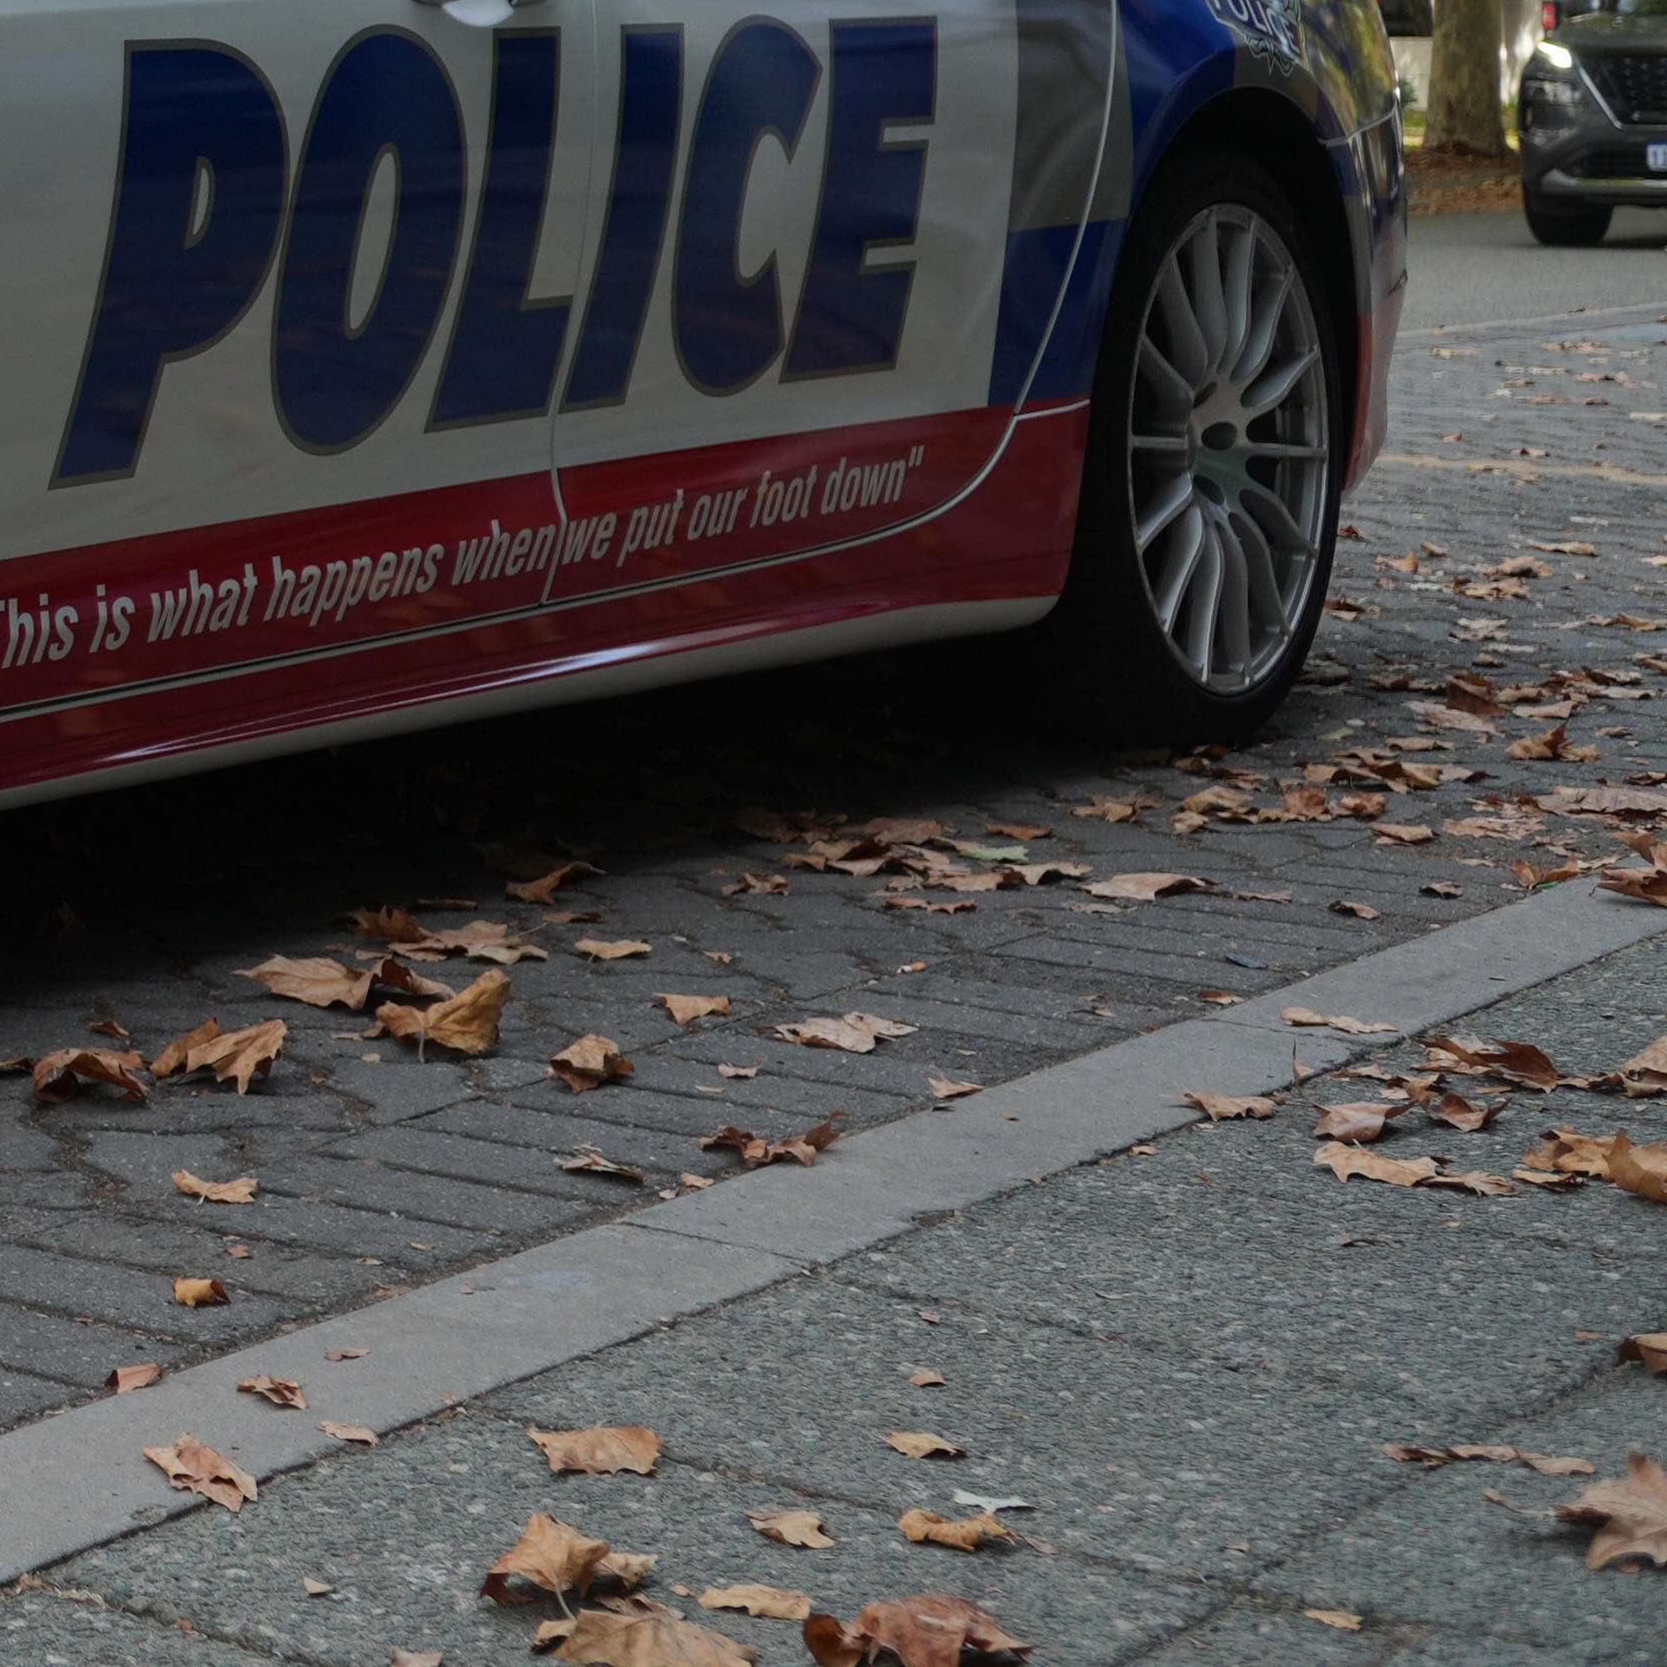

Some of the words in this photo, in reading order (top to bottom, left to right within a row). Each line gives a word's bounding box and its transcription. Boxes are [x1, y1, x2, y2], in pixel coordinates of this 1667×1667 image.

[47, 14, 938, 490] POLICE
[89, 584, 136, 654] is
[147, 562, 258, 643] what
[263, 555, 445, 627] happens
[451, 519, 557, 586] when
[562, 512, 617, 564] we
[616, 488, 685, 568] put
[687, 487, 748, 541] our
[750, 464, 818, 528] foot
[821, 445, 925, 515] down"
